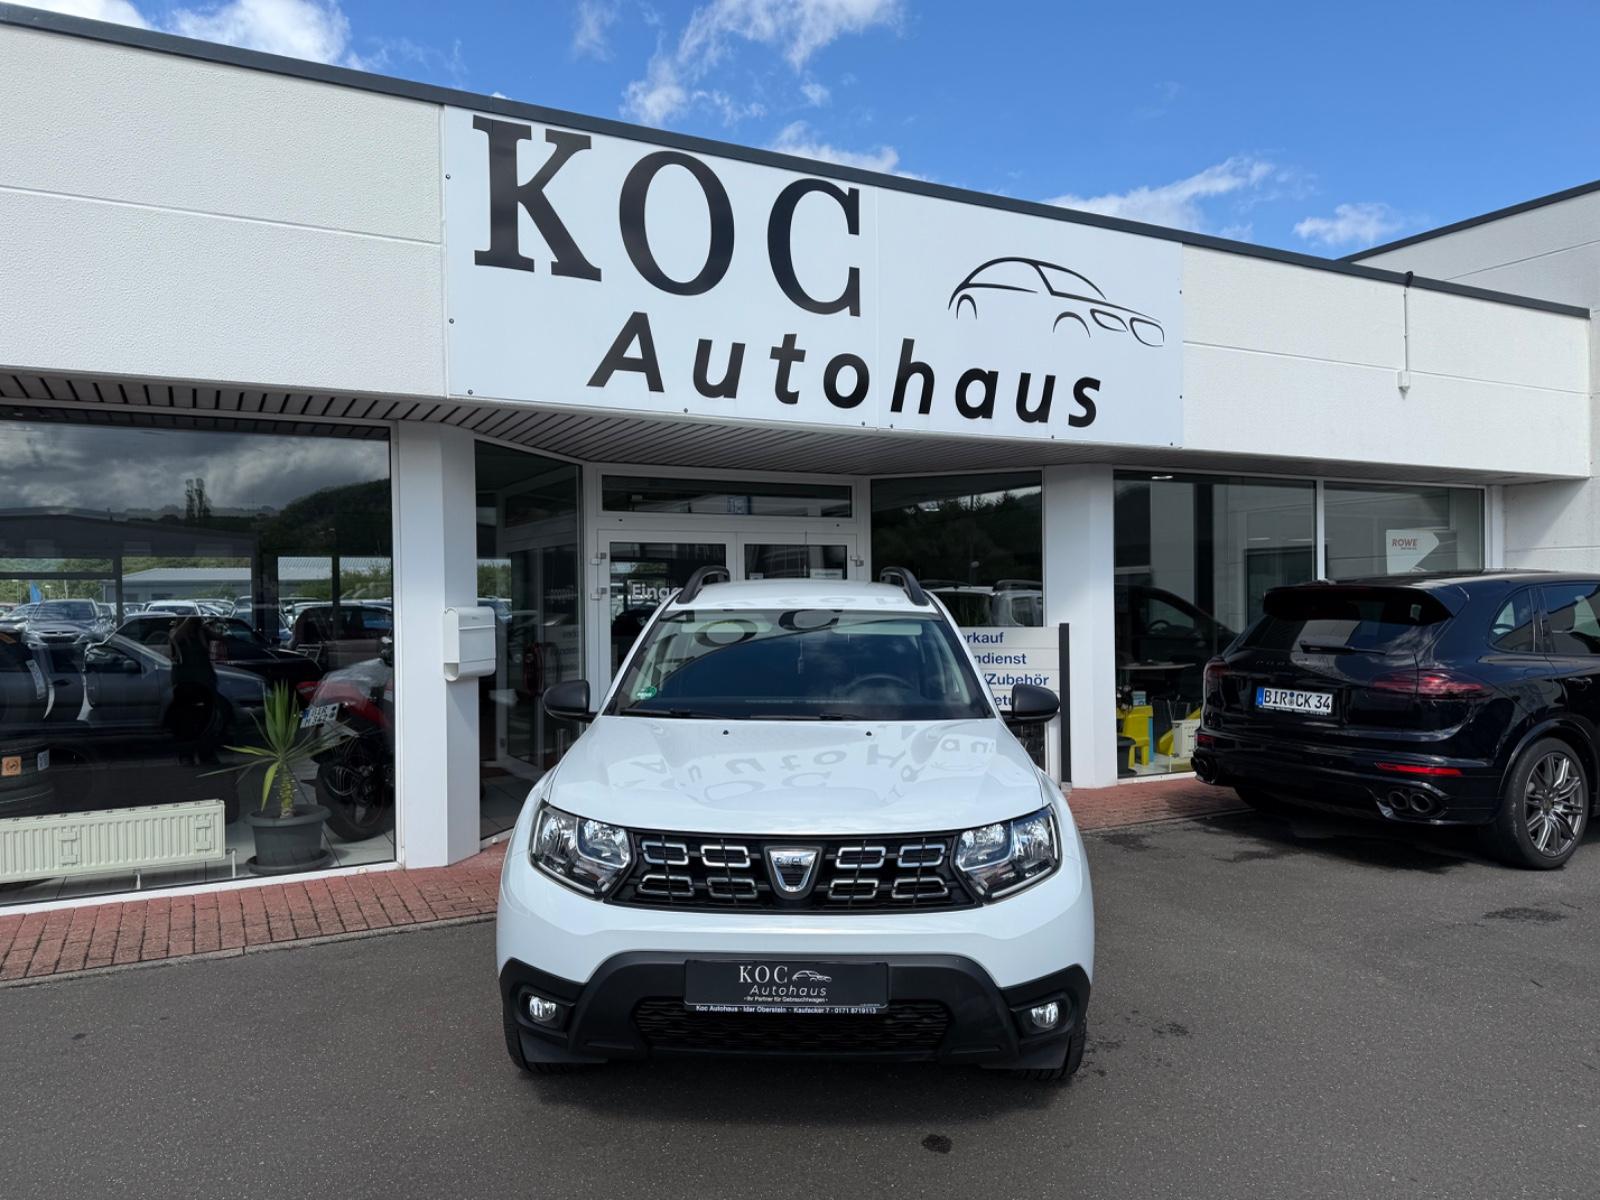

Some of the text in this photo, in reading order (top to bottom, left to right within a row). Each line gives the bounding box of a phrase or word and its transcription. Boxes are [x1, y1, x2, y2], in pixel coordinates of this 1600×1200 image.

[472, 115, 861, 318] KOC
[586, 311, 1102, 429] Autohaus
[1391, 538, 1418, 547] ROWE
[974, 652, 1027, 665] ndienst
[1263, 689, 1288, 706] BIR
[1295, 692, 1313, 709] CK
[1315, 695, 1331, 711] 34
[738, 965, 789, 984] KOC
[749, 984, 828, 997] Autohaus
